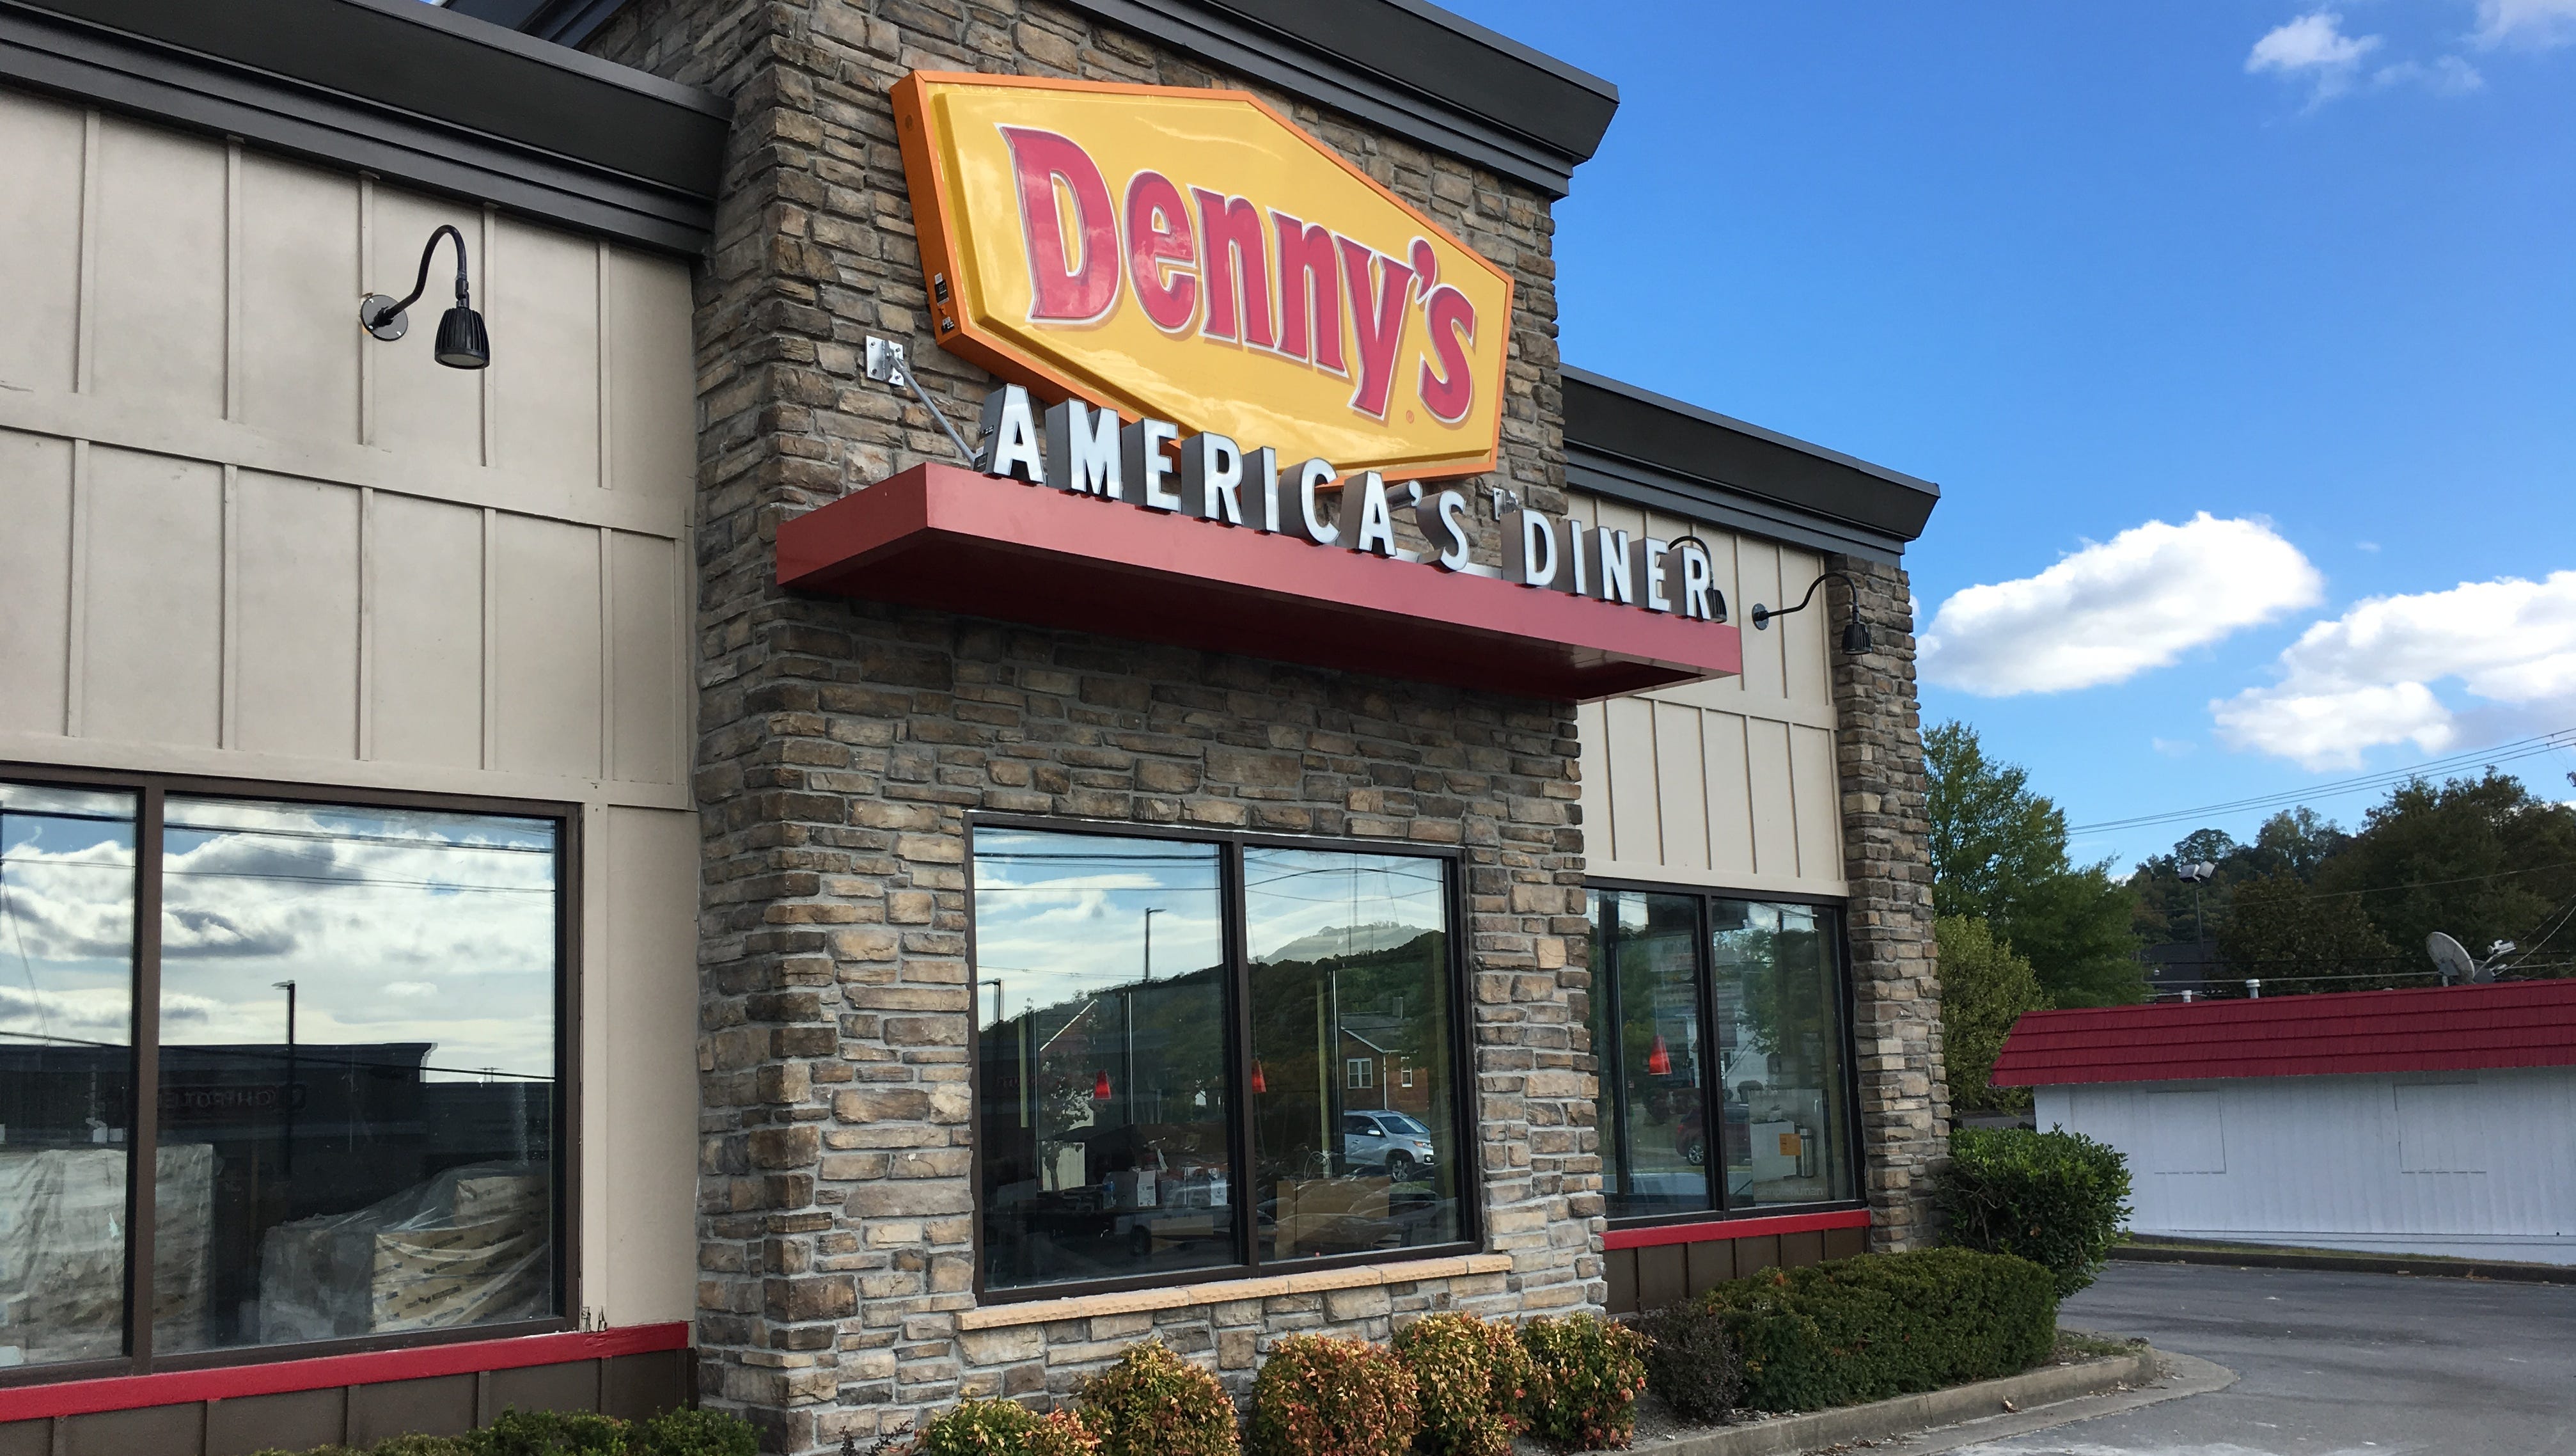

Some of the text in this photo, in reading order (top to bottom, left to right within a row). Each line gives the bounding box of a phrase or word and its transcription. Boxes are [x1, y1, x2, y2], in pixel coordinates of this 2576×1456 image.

[994, 123, 1475, 423] Denny's
[990, 383, 1711, 621] AMERICA'S DINER
